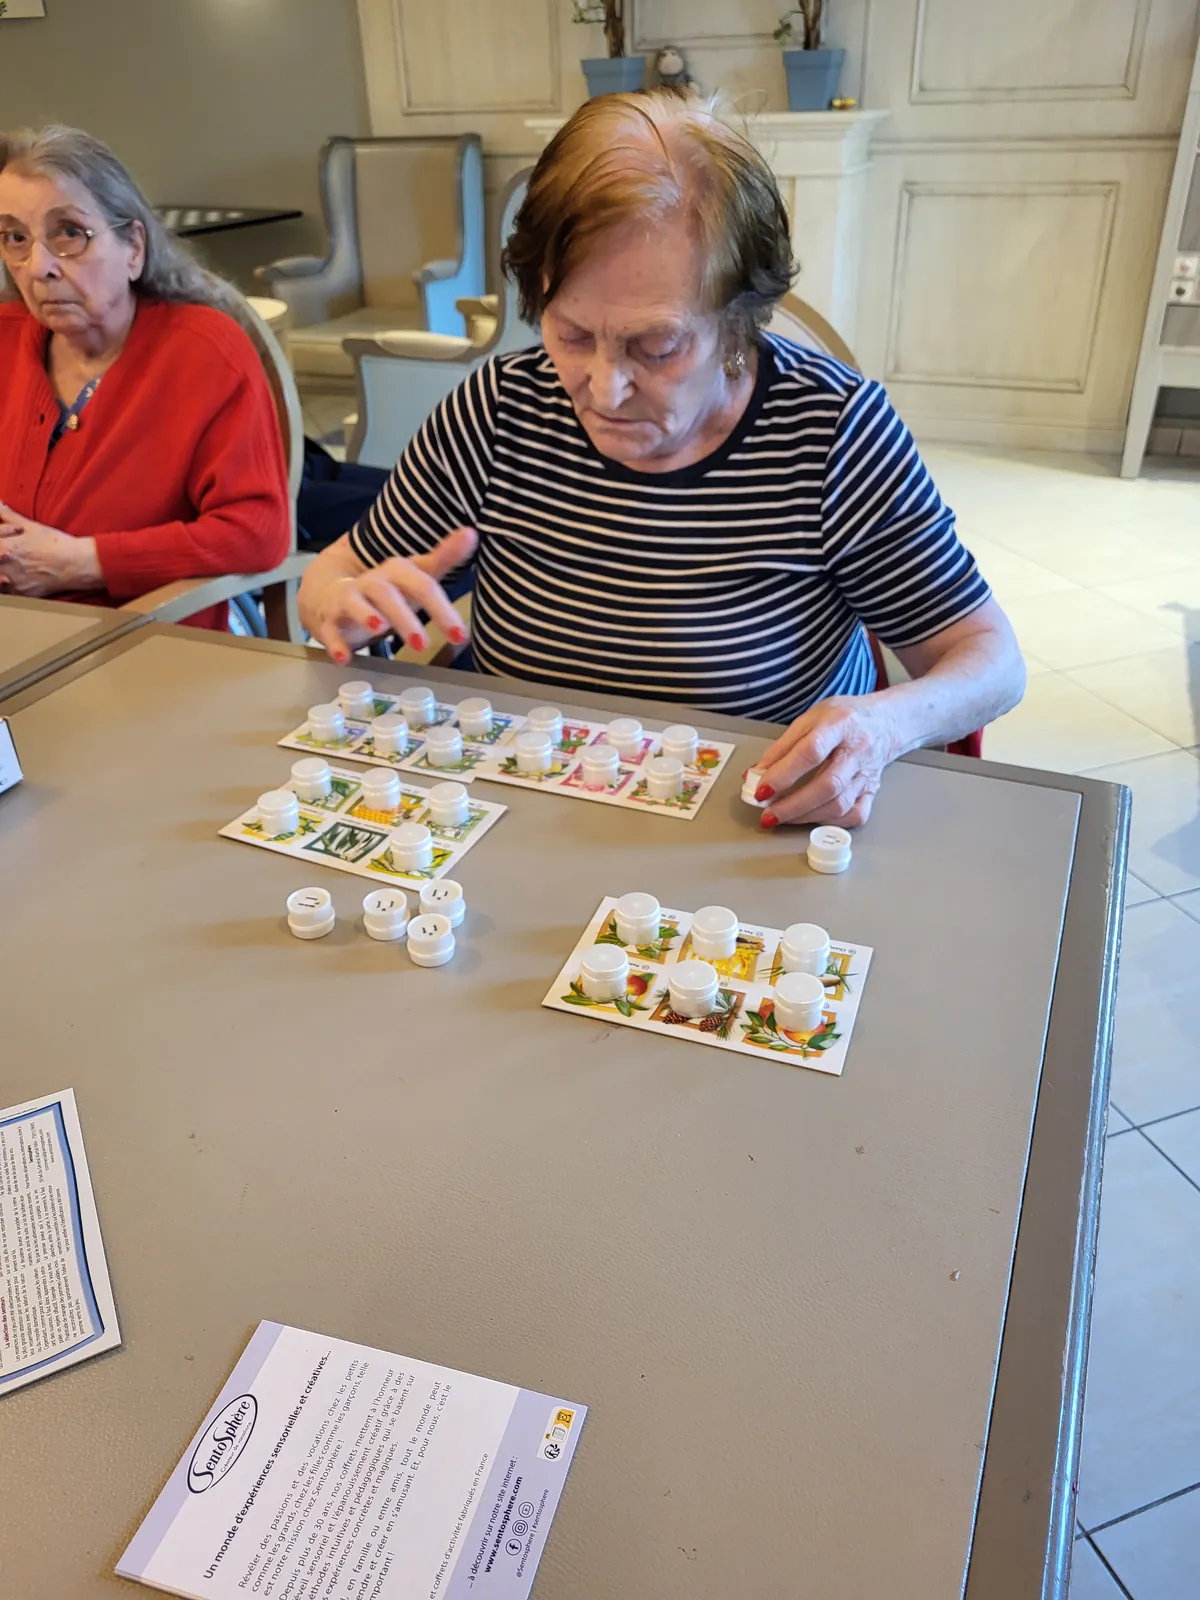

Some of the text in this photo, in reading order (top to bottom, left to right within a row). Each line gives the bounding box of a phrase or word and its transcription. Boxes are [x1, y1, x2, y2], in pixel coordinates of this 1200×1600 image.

[370, 1368, 395, 1407] l'honneur
[393, 1371, 406, 1387] des
[405, 1373, 416, 1388] sur
[441, 1383, 453, 1393] le
[380, 1394, 396, 1419] grâce
[390, 1388, 411, 1417] basent
[435, 1393, 449, 1413] c'est
[354, 1413, 375, 1448] mettent
[367, 1417, 385, 1446] créatif
[387, 1416, 398, 1428] se
[425, 1413, 442, 1437] nous,
[381, 1427, 393, 1443] qui
[416, 1436, 431, 1459] pour
[202, 1349, 333, 1580] Un monde d'expériences sensorielles et créatives...
[237, 1359, 360, 1590] Révéler des passions et des vocations chez les petits
[338, 1448, 359, 1481] coffrets
[352, 1443, 386, 1506] pédagogiques
[409, 1459, 423, 1472] Et,
[499, 1458, 518, 1490] internet
[251, 1361, 371, 1594] comme les grands, chez les filles comme les garçons, telle
[329, 1446, 373, 1522] l'épanouissement
[345, 1380, 443, 1592] en famille ou entre amis, tout le monde peut
[330, 1481, 344, 1499] nos
[390, 1472, 417, 1519] s'amusant.
[495, 1488, 508, 1504] site
[262, 1580, 276, 1597] est
[270, 1553, 289, 1581] notre
[283, 1518, 307, 1555] mission
[301, 1496, 318, 1519] chez
[310, 1443, 344, 1497] Sentosphère
[320, 1499, 336, 1518] ans,
[324, 1441, 400, 1596] expériences concrètes et magiques.
[347, 1505, 358, 1517] et
[488, 1502, 503, 1525] notre
[312, 1517, 326, 1532] 30
[326, 1522, 337, 1534] et
[384, 1519, 396, 1534] en
[428, 1452, 490, 1600] et coffrets d'activités fabriqués en France
[483, 1475, 524, 1574] www.sentosphere.com
[484, 1523, 495, 1538] sur
[306, 1531, 319, 1546] de
[324, 1517, 352, 1560] intuitives
[374, 1533, 390, 1559] créer
[296, 1545, 312, 1568] plus
[305, 1533, 331, 1577] sensoriel
[368, 1559, 379, 1572] et
[469, 1535, 490, 1576] découvrir
[466, 1574, 477, 1582] à
